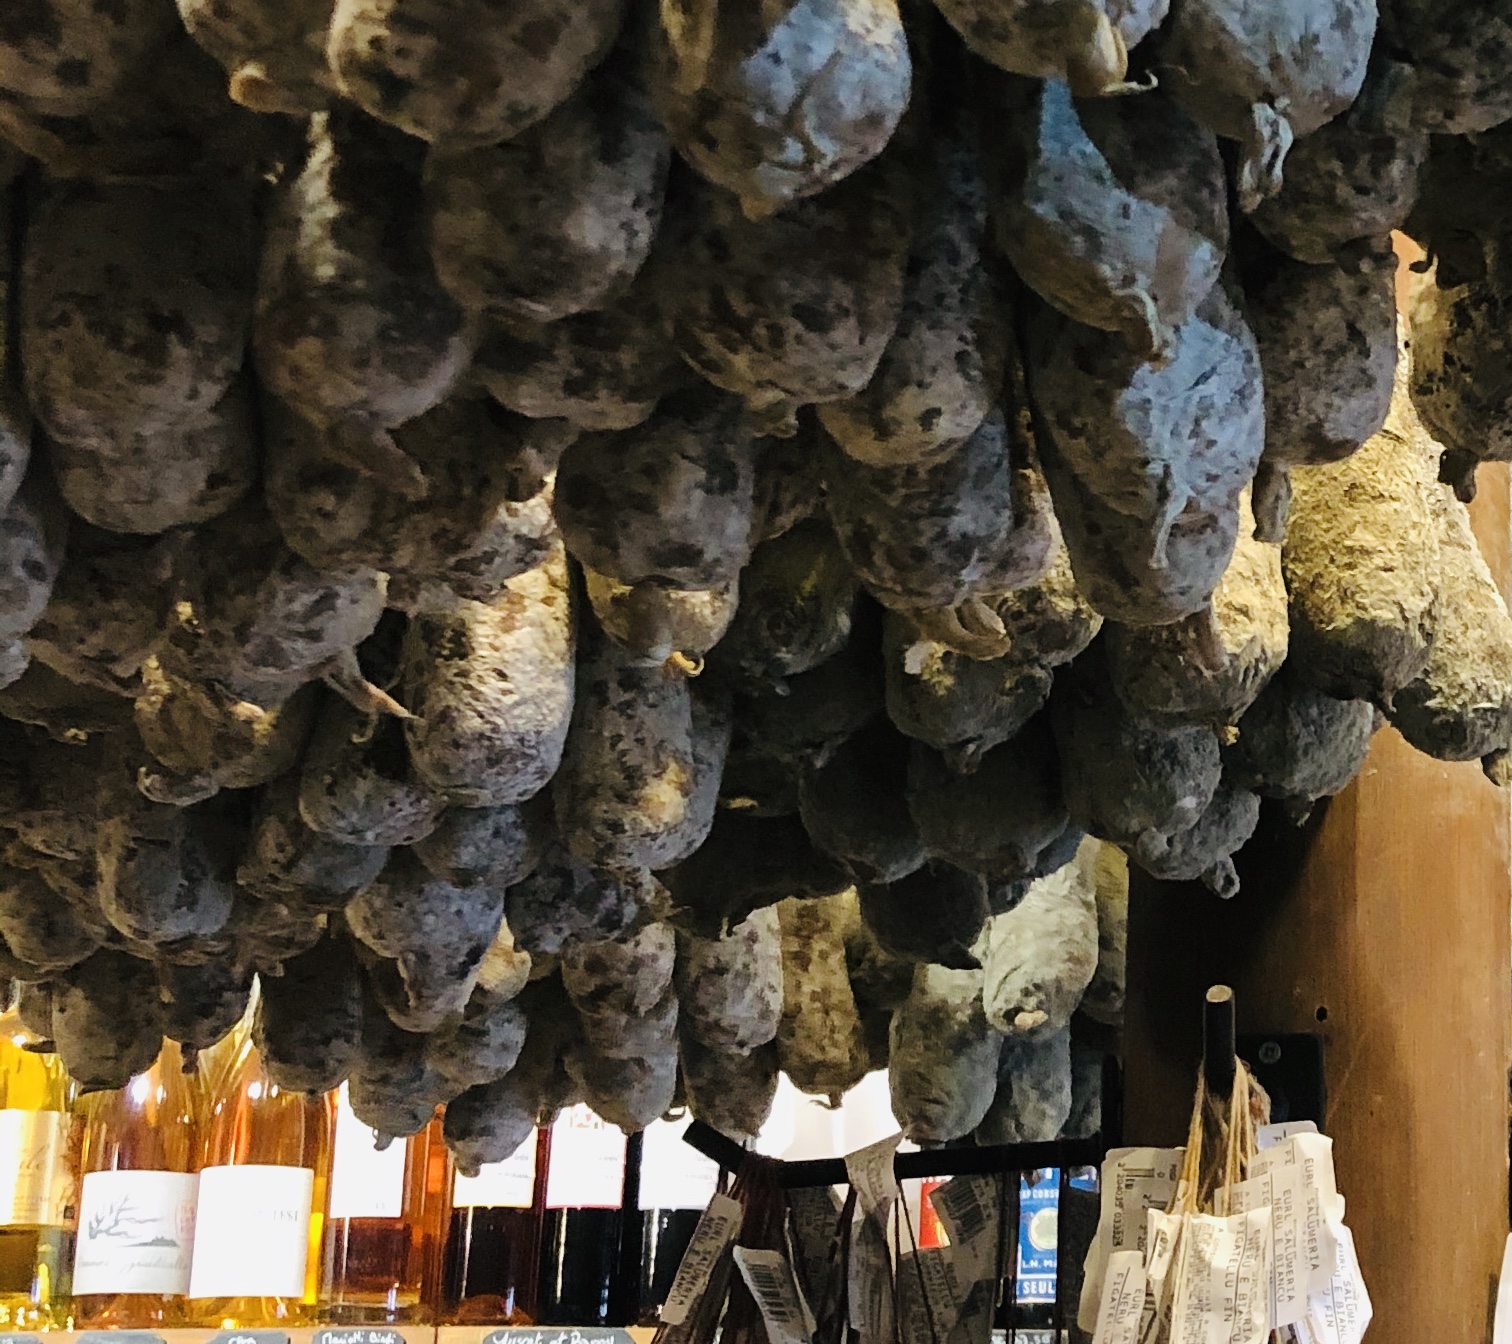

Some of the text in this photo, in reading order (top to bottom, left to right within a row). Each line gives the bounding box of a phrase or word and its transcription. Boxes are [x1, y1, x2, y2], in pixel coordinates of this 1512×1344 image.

[1273, 1197, 1284, 1230] NERU
[1306, 1197, 1321, 1272] SALUMERIA
[1282, 1188, 1296, 1303] EURL SALUMERIA
[1275, 1253, 1286, 1304] BIANCU
[1223, 1297, 1233, 1323] FIN
